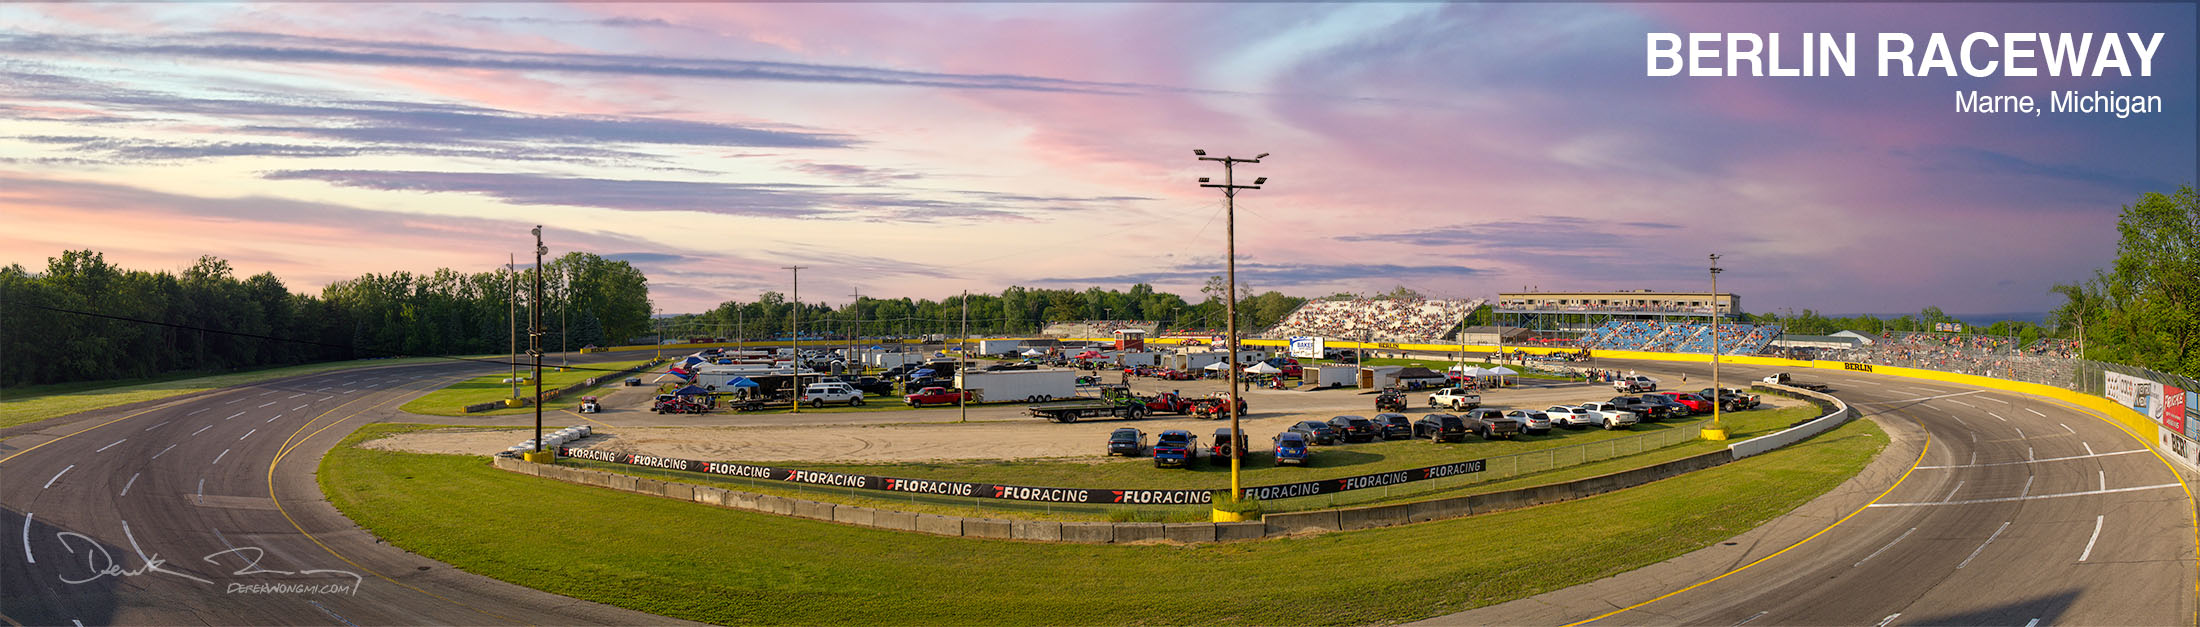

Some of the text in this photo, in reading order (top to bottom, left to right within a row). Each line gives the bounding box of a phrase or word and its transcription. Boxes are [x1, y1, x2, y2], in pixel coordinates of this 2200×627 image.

[1844, 362, 1872, 372] BERLIN
[568, 448, 615, 463] FLORACING
[634, 455, 687, 470] FLORACING
[709, 463, 770, 479] FLORACING
[1429, 461, 1481, 478] FLORACING
[796, 470, 866, 488] FLORACING
[1347, 471, 1408, 490] FLORACING
[895, 479, 972, 496] FLORACING
[1003, 486, 1088, 502] FLORACING
[1243, 482, 1320, 500] FLORACING
[1123, 490, 1211, 504] FLORACING
